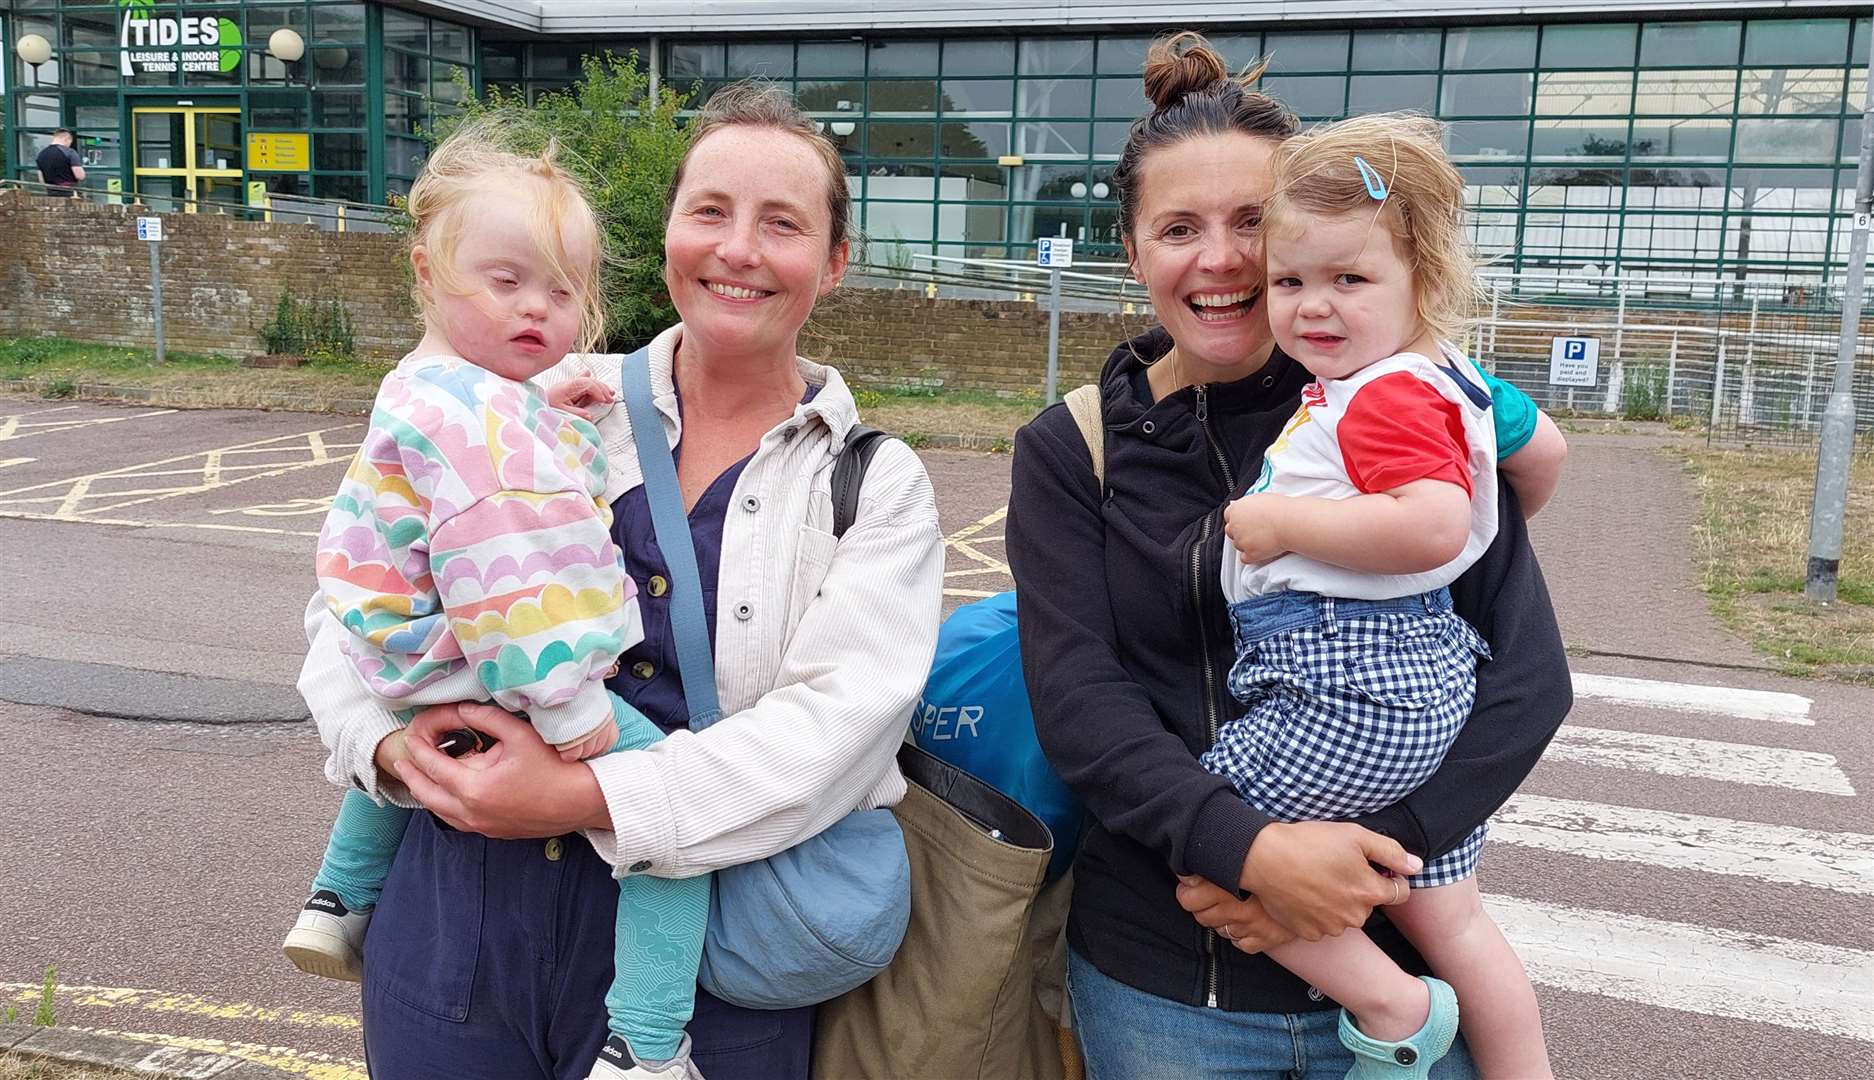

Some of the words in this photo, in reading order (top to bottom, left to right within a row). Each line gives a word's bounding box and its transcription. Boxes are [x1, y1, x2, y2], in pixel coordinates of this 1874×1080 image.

[130, 17, 219, 46] TIDES
[130, 52, 170, 62] LEISURE
[172, 52, 179, 61] &
[182, 51, 219, 61] INDOOR
[142, 62, 177, 72] TENNIS
[182, 62, 219, 71] CENTRE
[1858, 215, 1866, 226] 6
[1042, 241, 1049, 251] P
[1568, 342, 1582, 359] P
[912, 697, 984, 741] SPER
[311, 898, 336, 908] adidas
[602, 1045, 623, 1059] didas
